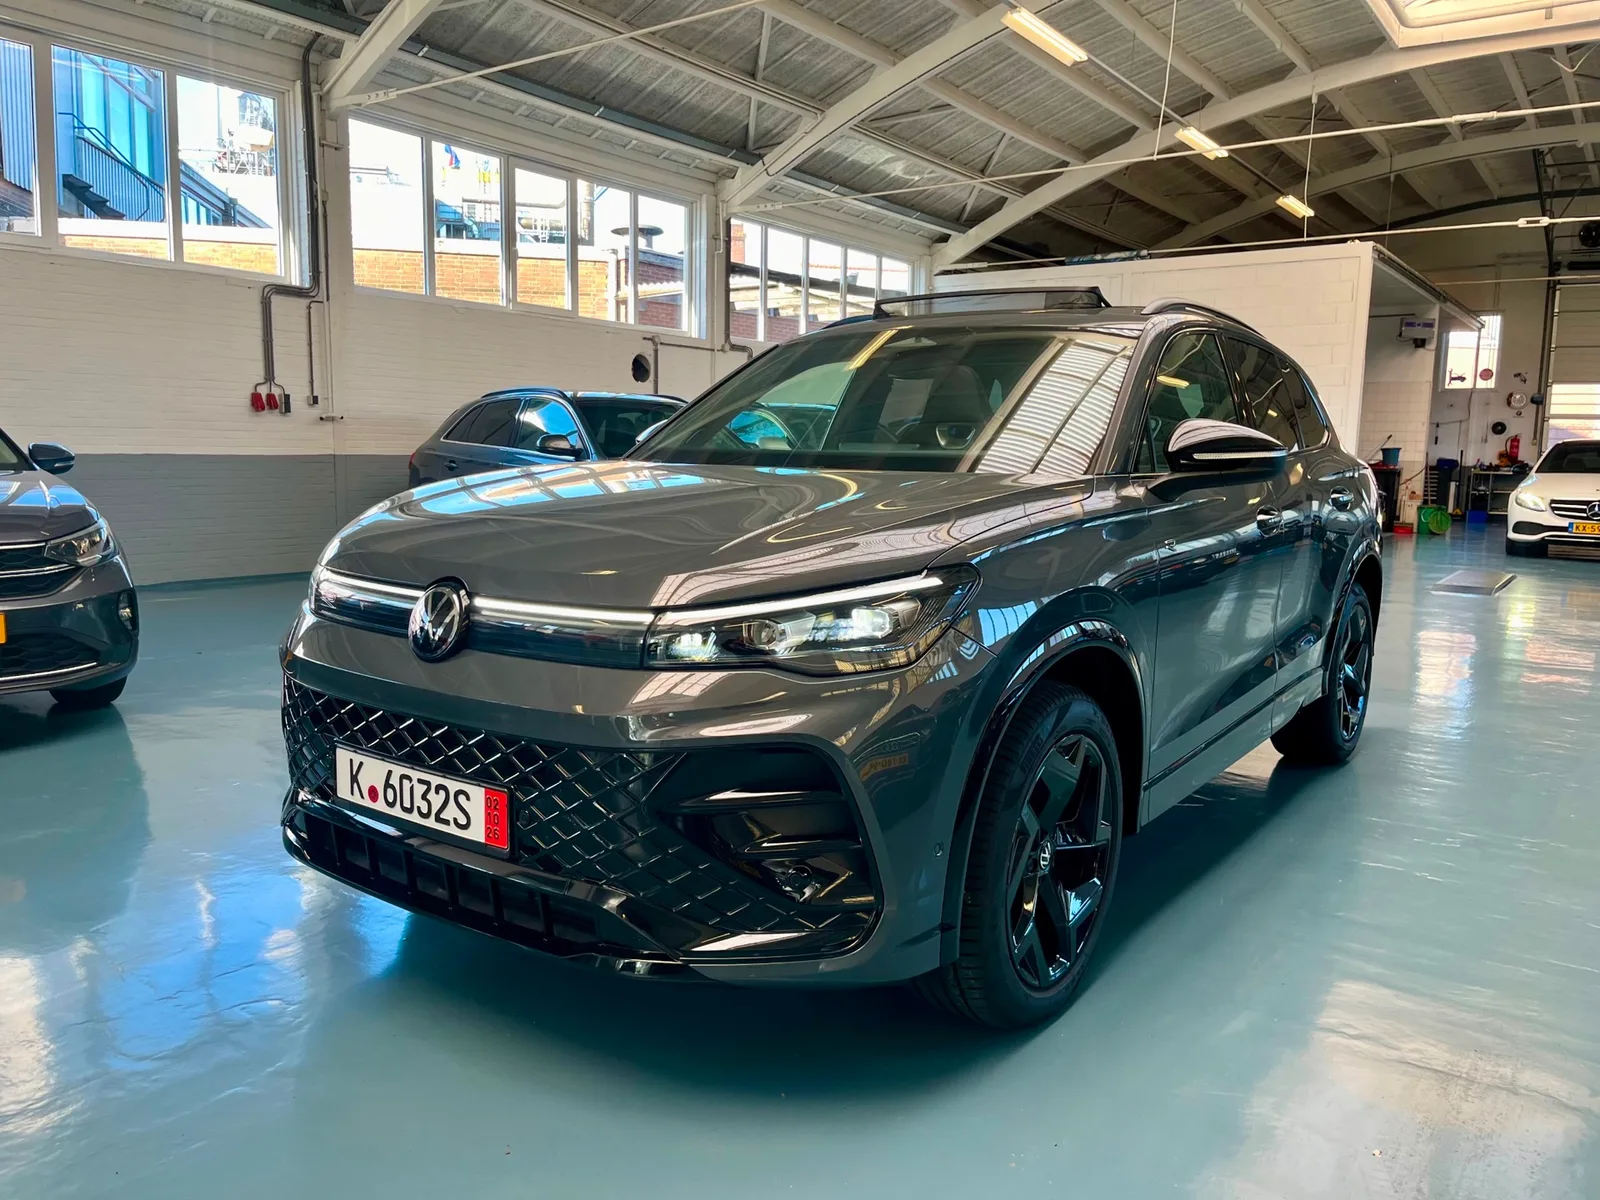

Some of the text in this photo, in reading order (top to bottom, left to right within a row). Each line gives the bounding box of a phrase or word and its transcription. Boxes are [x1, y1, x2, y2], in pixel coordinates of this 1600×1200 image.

[349, 757, 472, 831] K 6032S
[486, 796, 500, 811] 02
[486, 810, 500, 825] 10
[486, 826, 500, 840] 26
